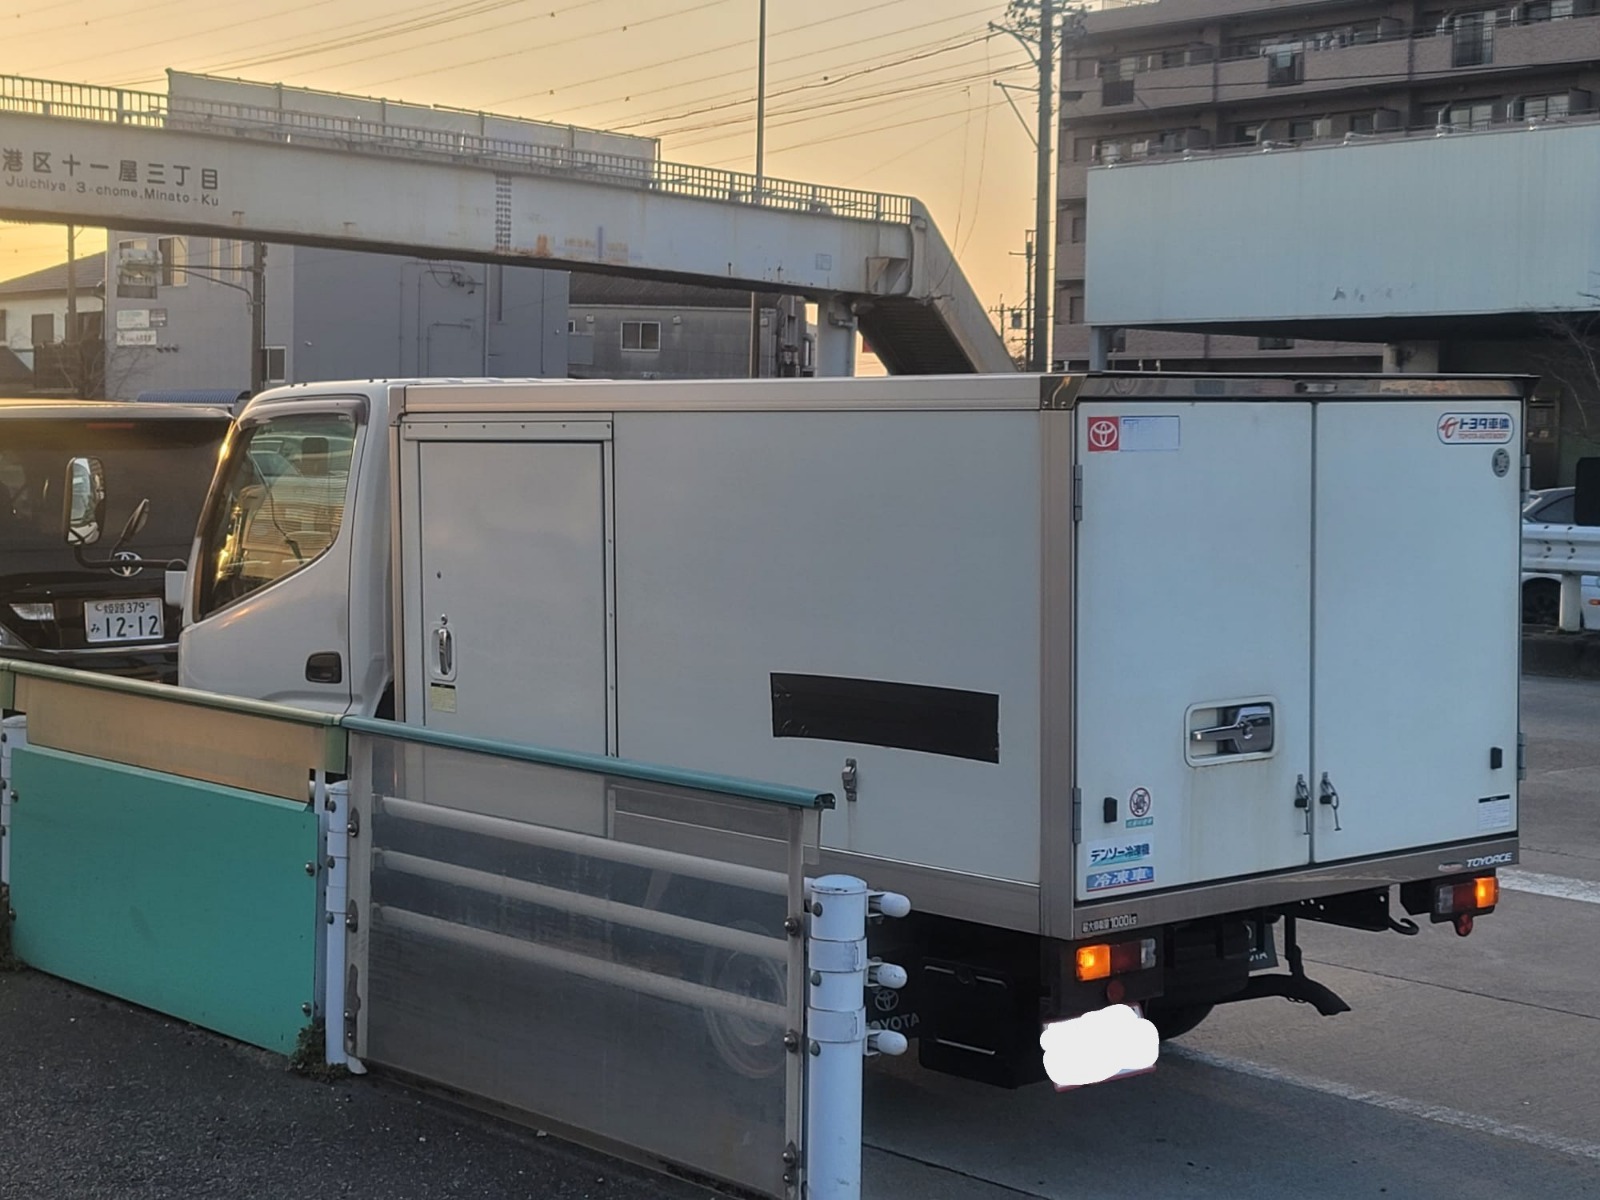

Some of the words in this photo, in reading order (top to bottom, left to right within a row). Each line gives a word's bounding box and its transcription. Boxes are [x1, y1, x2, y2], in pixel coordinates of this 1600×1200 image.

[2, 148, 219, 190] 港区十一屋三丁目
[106, 615, 159, 638] 12-12
[1467, 852, 1512, 868] TOYOACE
